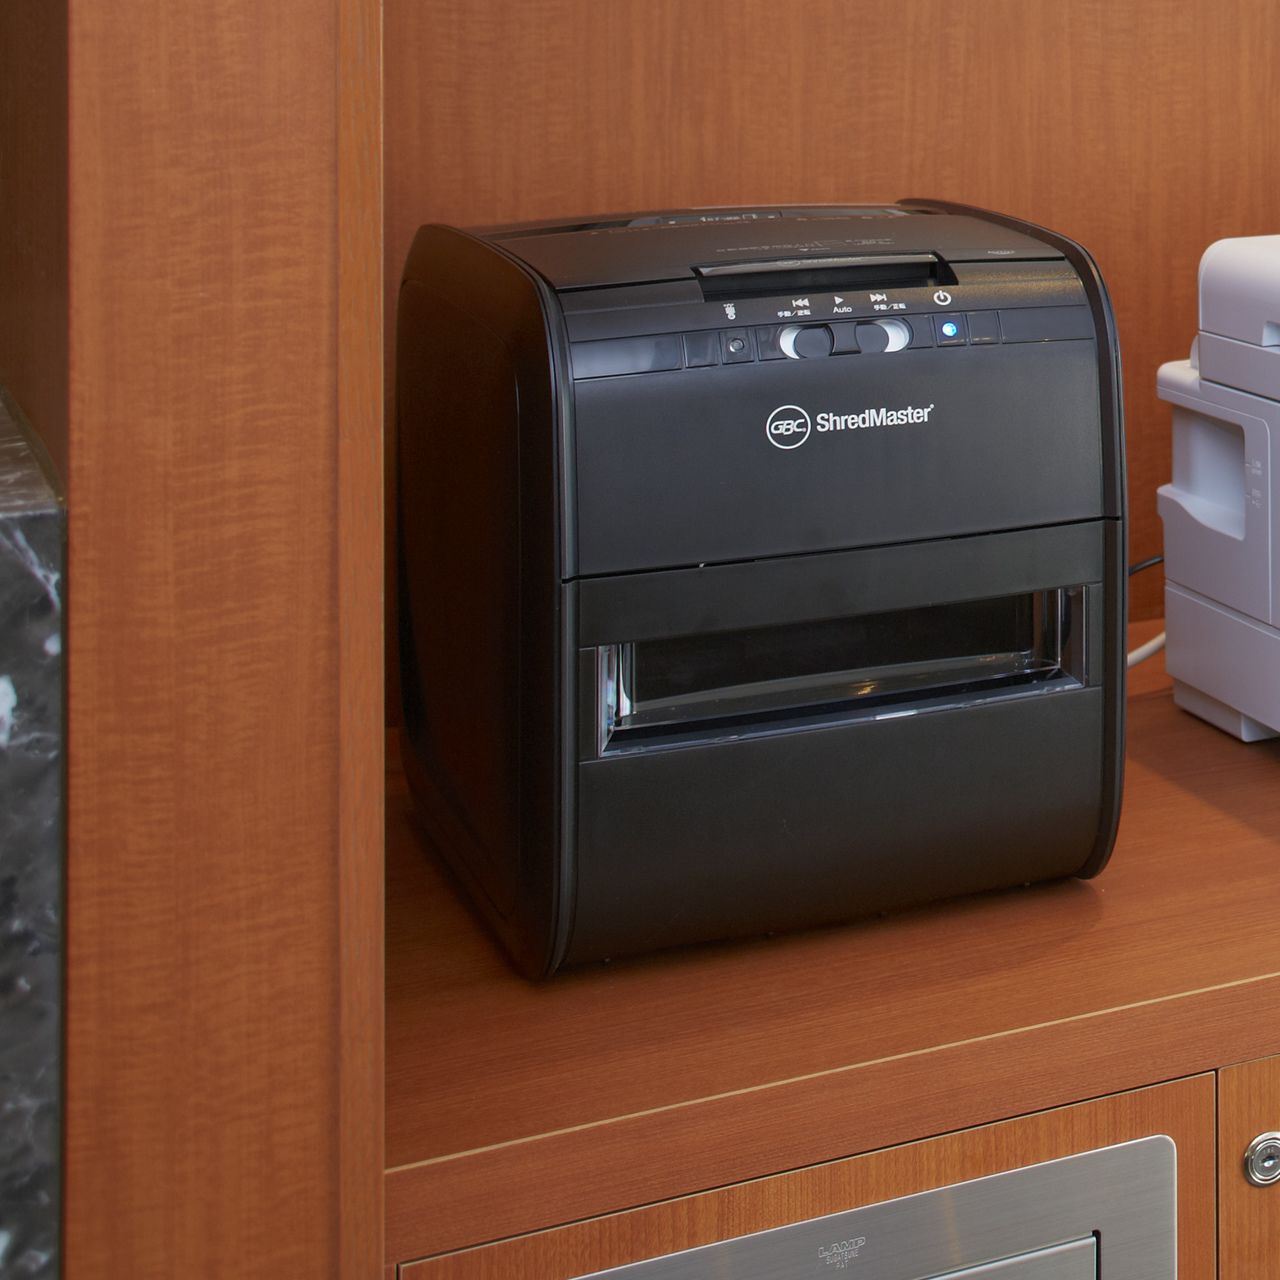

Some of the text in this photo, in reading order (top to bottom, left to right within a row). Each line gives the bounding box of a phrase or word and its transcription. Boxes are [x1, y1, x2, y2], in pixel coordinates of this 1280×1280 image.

[833, 305, 853, 314] Auto
[770, 405, 933, 435] GBC ShredMaster
[818, 1236, 866, 1258] LAMP
